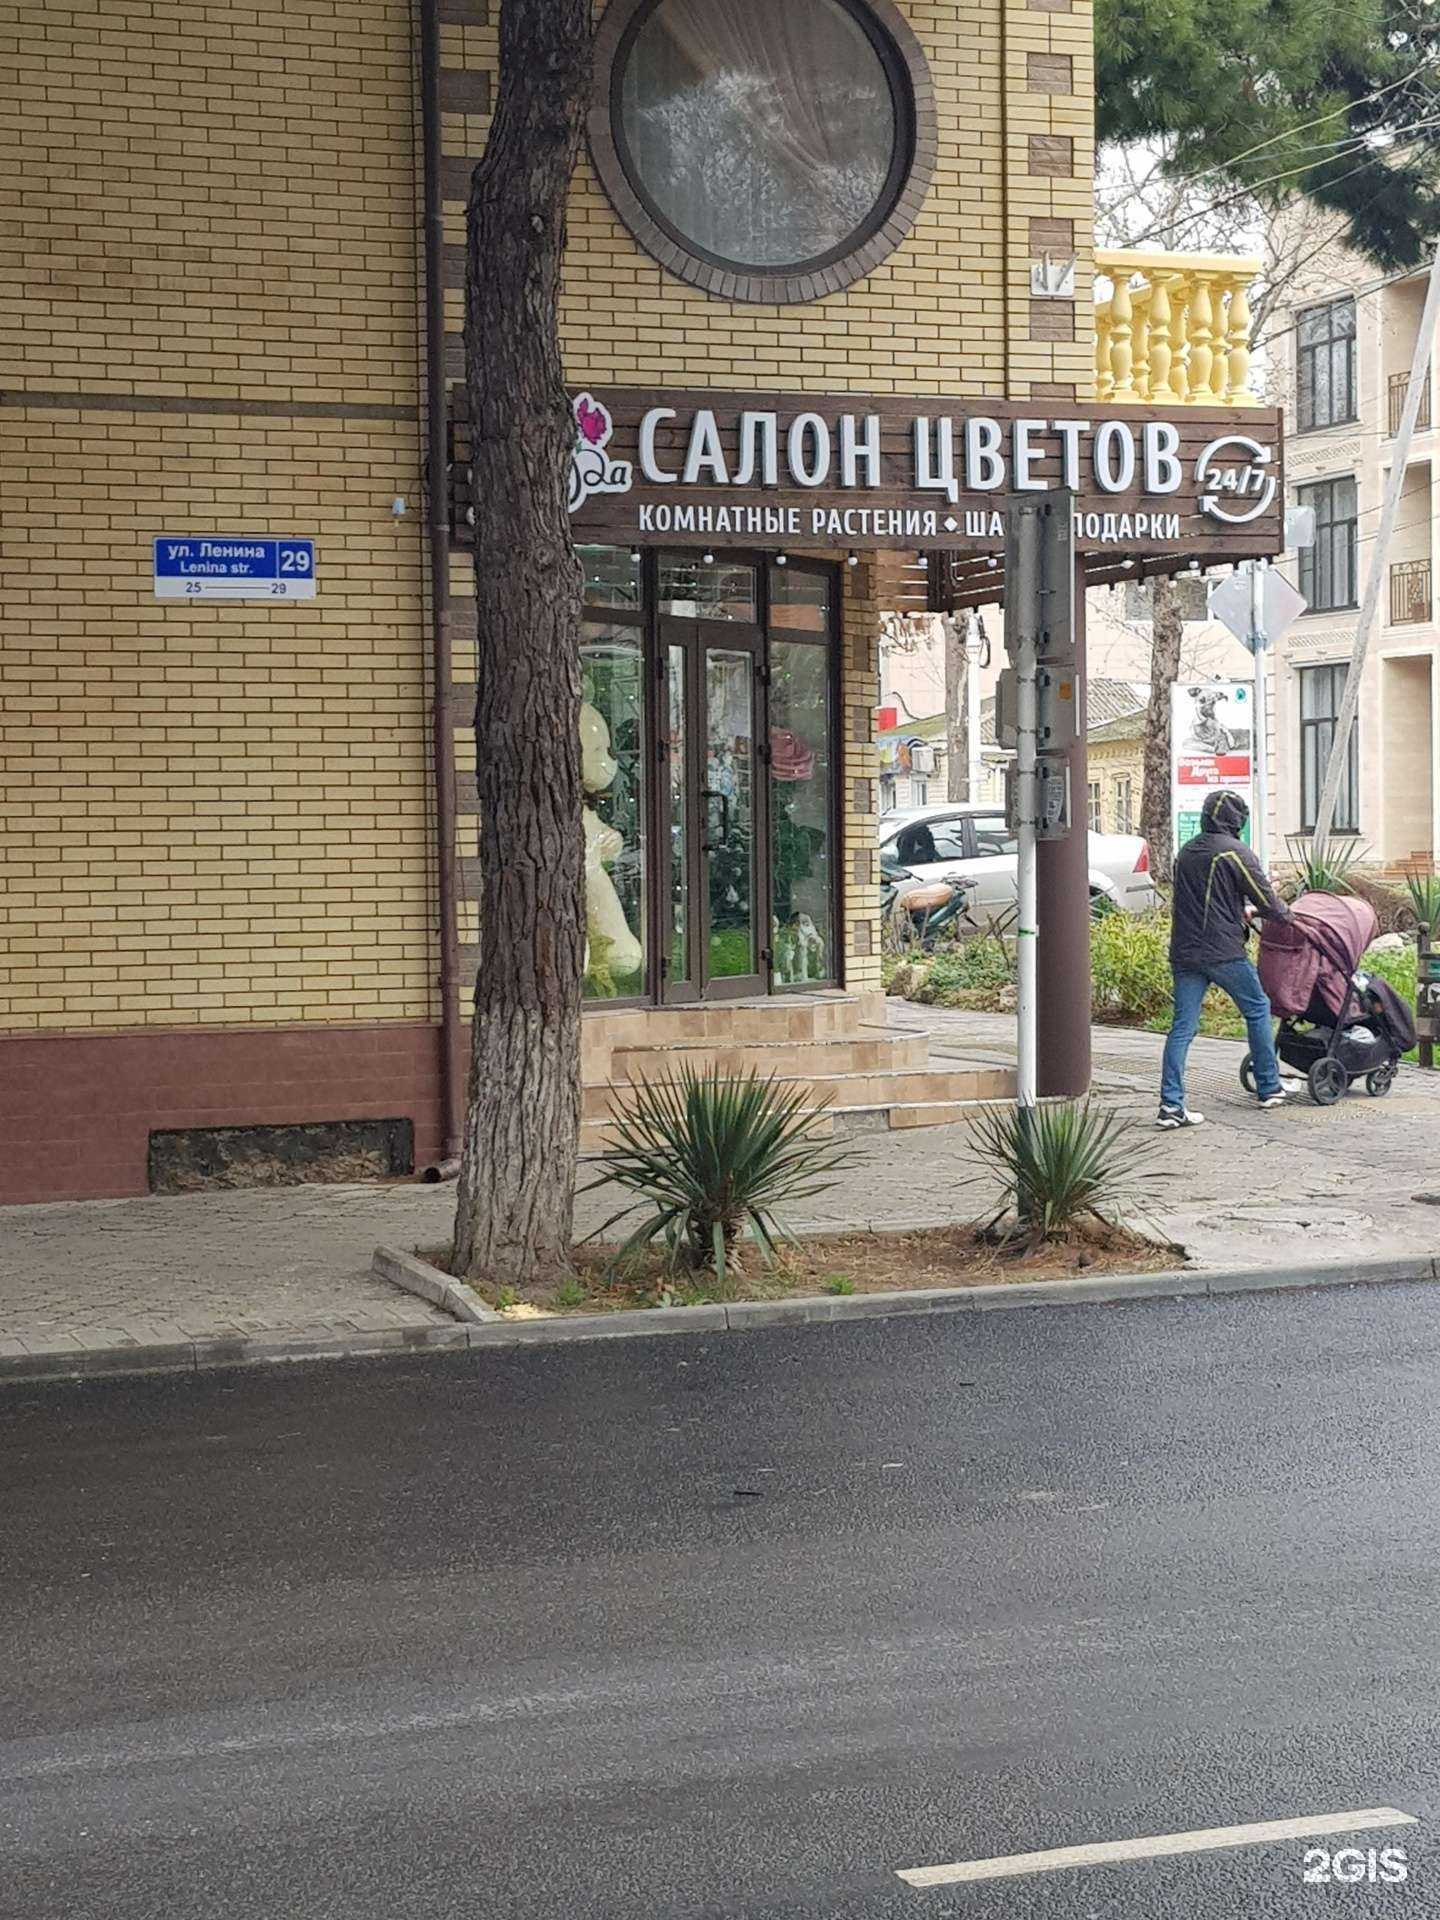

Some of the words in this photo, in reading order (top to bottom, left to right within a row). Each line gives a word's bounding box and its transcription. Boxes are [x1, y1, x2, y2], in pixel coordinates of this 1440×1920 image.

[638, 407, 881, 487] САЛОН
[913, 416, 1183, 503] ЦВЕТОВ
[1206, 465, 1265, 494] 24/7
[638, 504, 801, 534] КОМНАТНЫЕ
[812, 508, 937, 537] РАСТЕНИЯ
[964, 511, 1005, 537] ША
[1072, 512, 1180, 543] ПОДАРКИ
[168, 545, 194, 560] ул.
[200, 543, 265, 558] Ленина
[280, 551, 310, 572] 29
[180, 561, 227, 574] Lenina
[230, 563, 254, 574] str.
[186, 582, 202, 593] 25
[271, 583, 287, 594] 29
